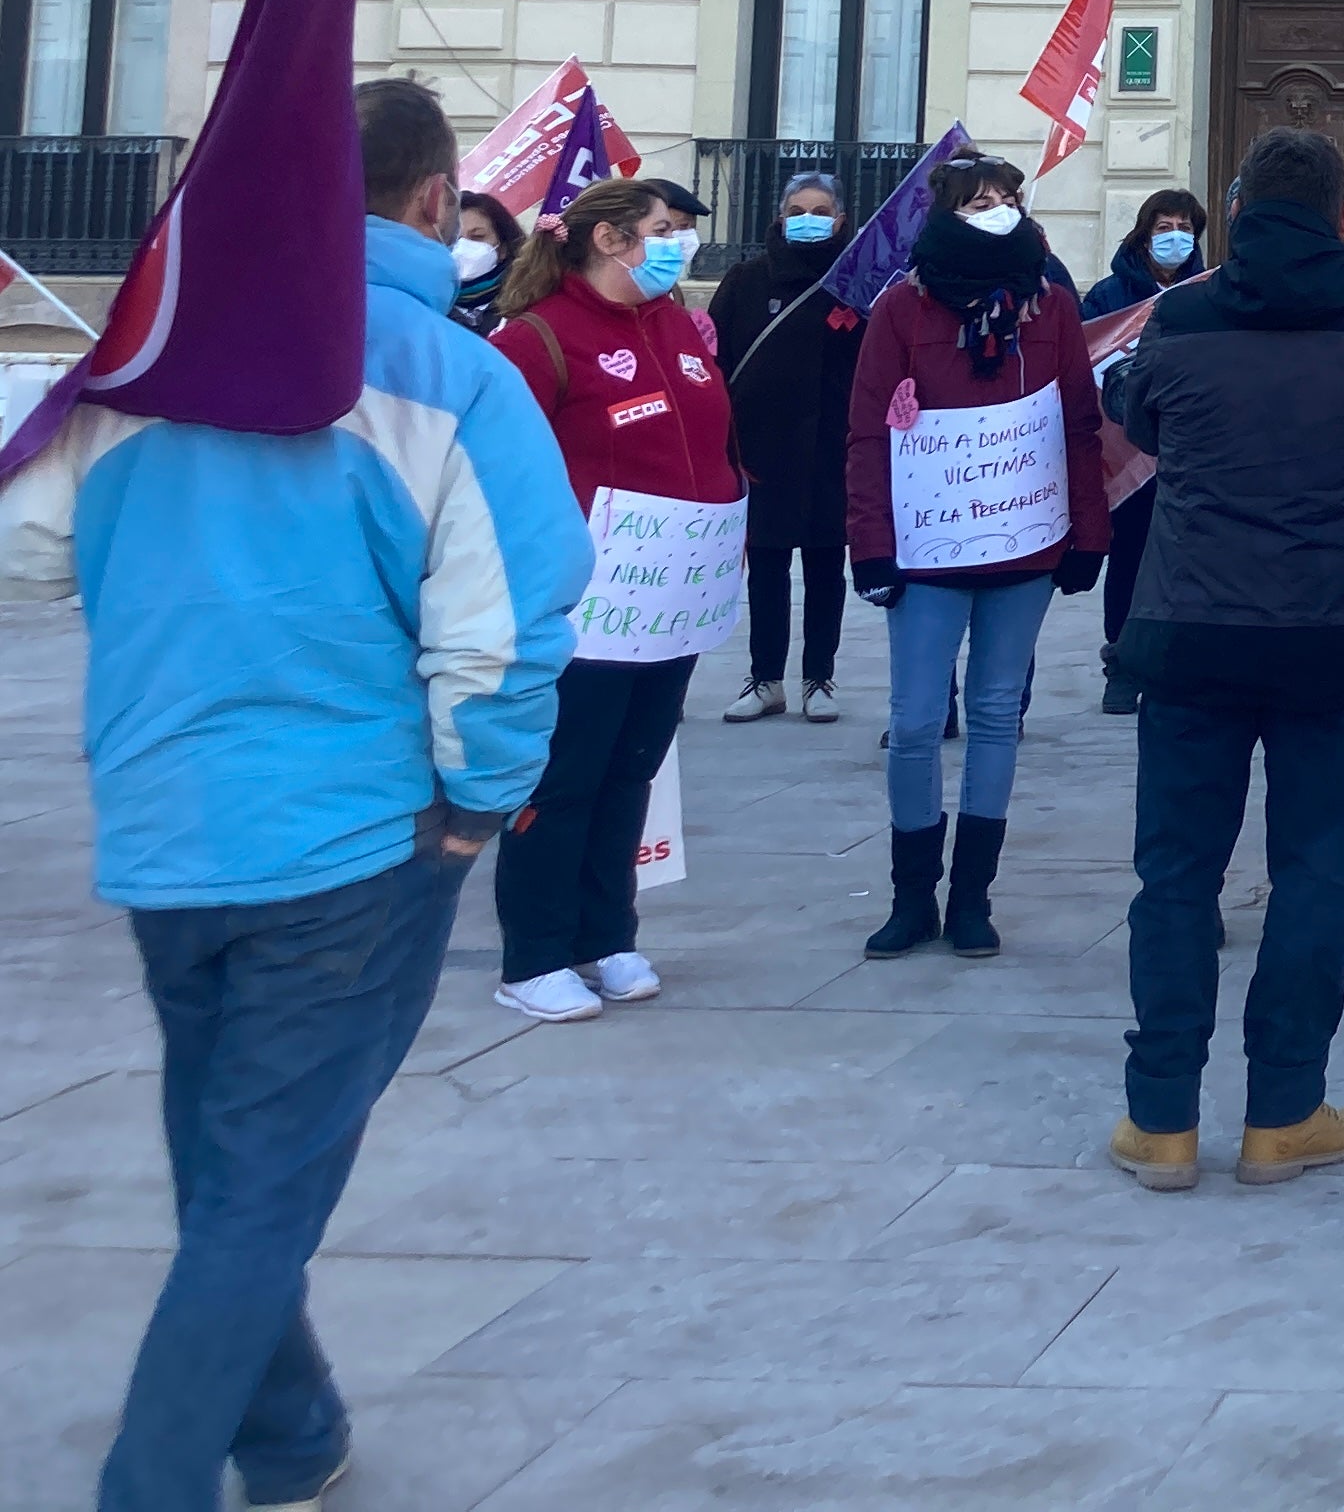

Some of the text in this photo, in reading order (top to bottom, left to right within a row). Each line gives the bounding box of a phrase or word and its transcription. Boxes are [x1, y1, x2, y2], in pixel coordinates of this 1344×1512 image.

[614, 399, 668, 426] CCOO
[899, 415, 1049, 457] AYUDA A DOMICILIO
[944, 450, 1038, 486] VICTIMAS
[613, 510, 670, 539] AUX
[914, 508, 935, 529] DE
[939, 508, 963, 524] LA
[684, 564, 706, 585] TE
[580, 596, 642, 638] POR
[649, 610, 690, 637] LA
